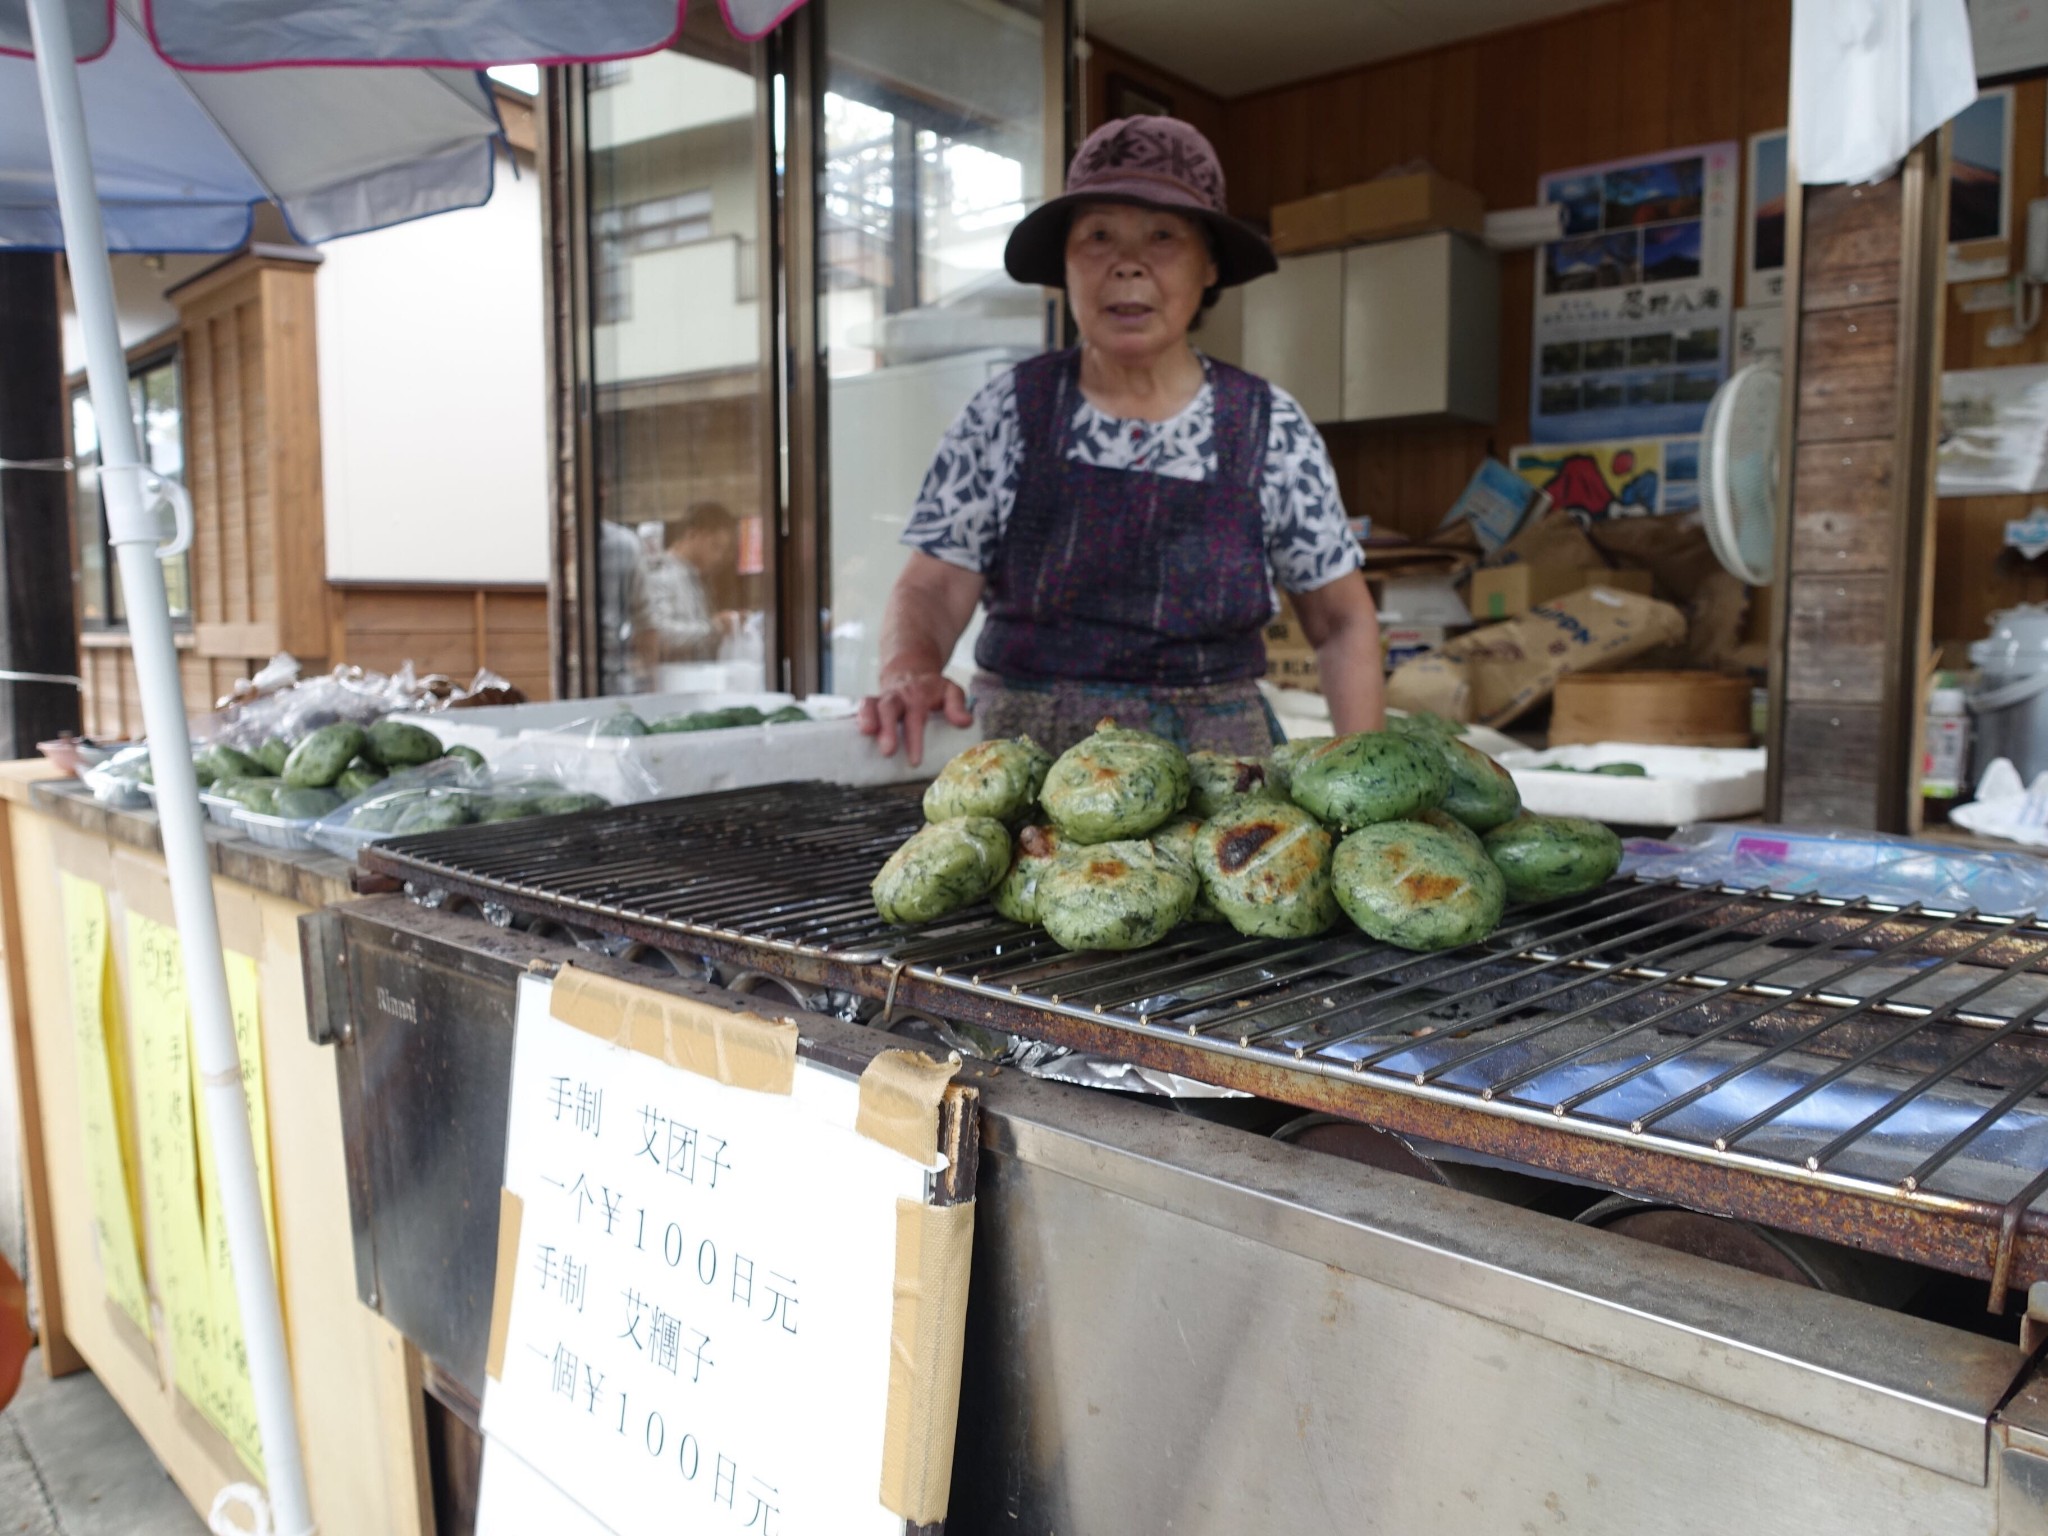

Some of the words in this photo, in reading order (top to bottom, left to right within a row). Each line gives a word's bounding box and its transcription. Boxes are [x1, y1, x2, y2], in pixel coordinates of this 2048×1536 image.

[546, 1075, 604, 1140] 手制
[633, 1104, 733, 1190] 艾团子
[533, 1243, 589, 1314] 手制
